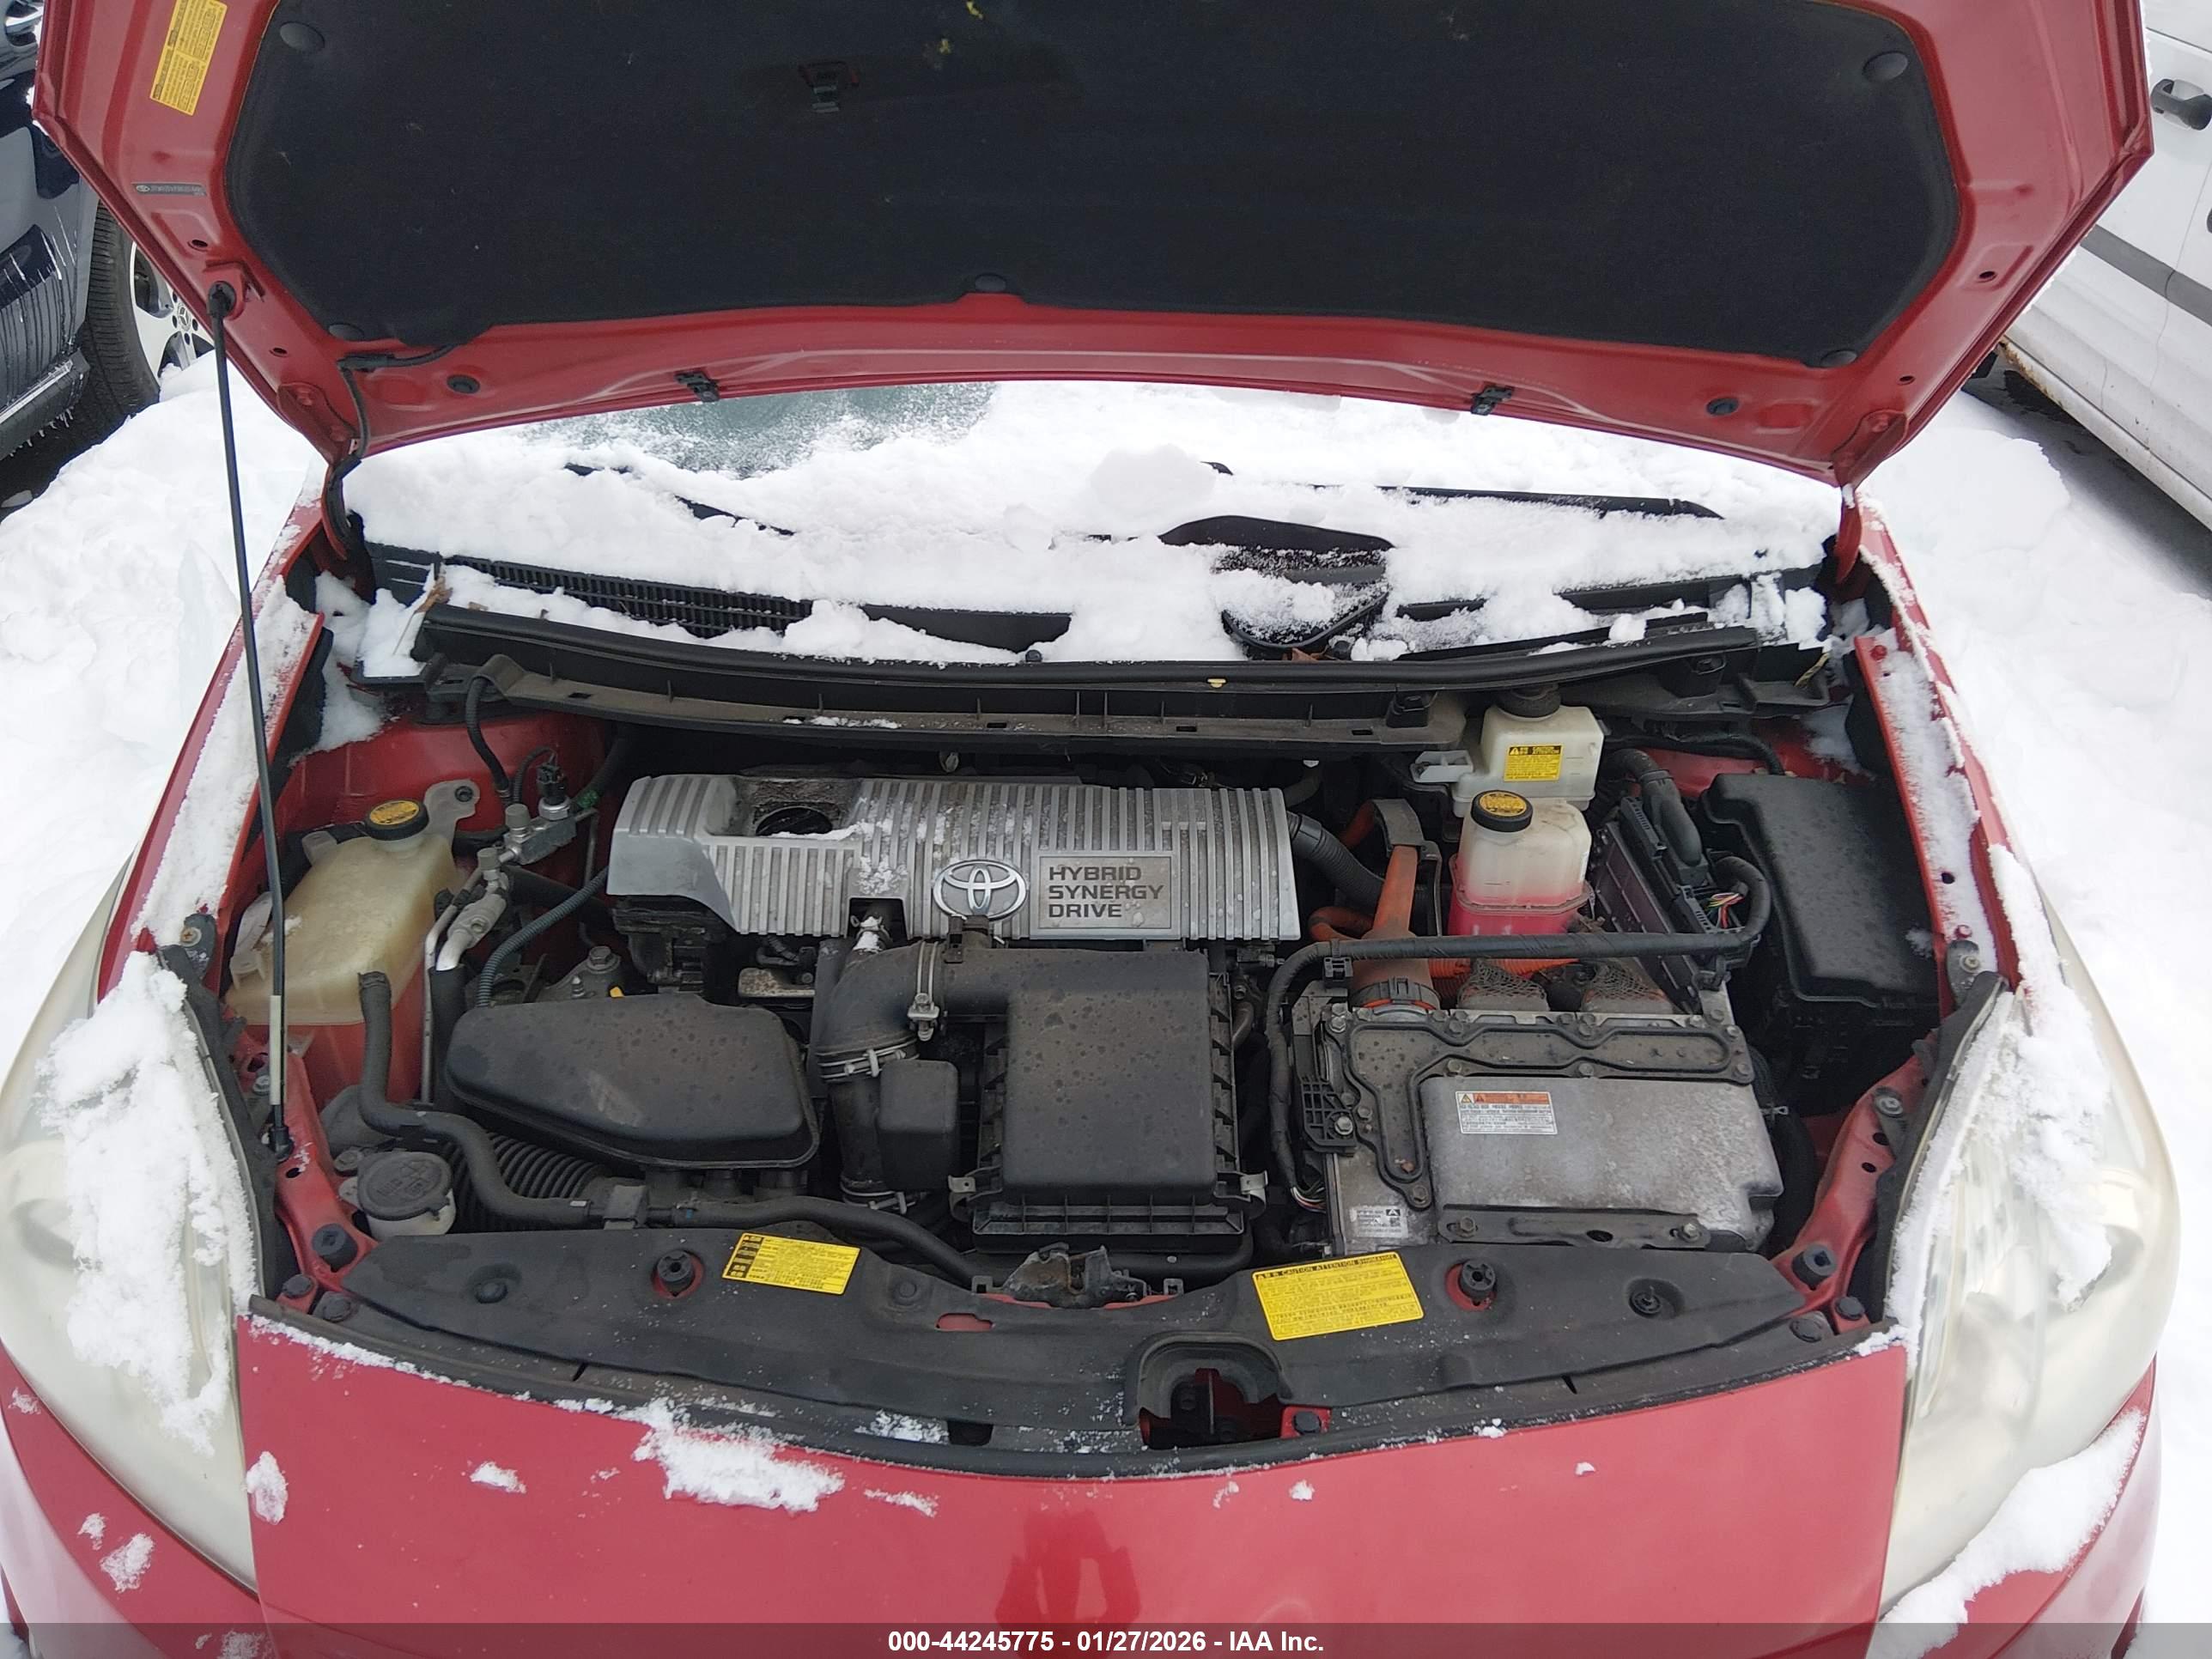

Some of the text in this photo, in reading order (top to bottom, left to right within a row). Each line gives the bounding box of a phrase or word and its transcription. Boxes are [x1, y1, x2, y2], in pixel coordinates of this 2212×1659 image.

[1049, 866, 1142, 881] HYBRID
[1048, 884, 1164, 900] SYNERGY
[1048, 903, 1122, 918] DRIVE
[1282, 1267, 1314, 1276] CAUTION
[1316, 1261, 1355, 1271] ATTENTION
